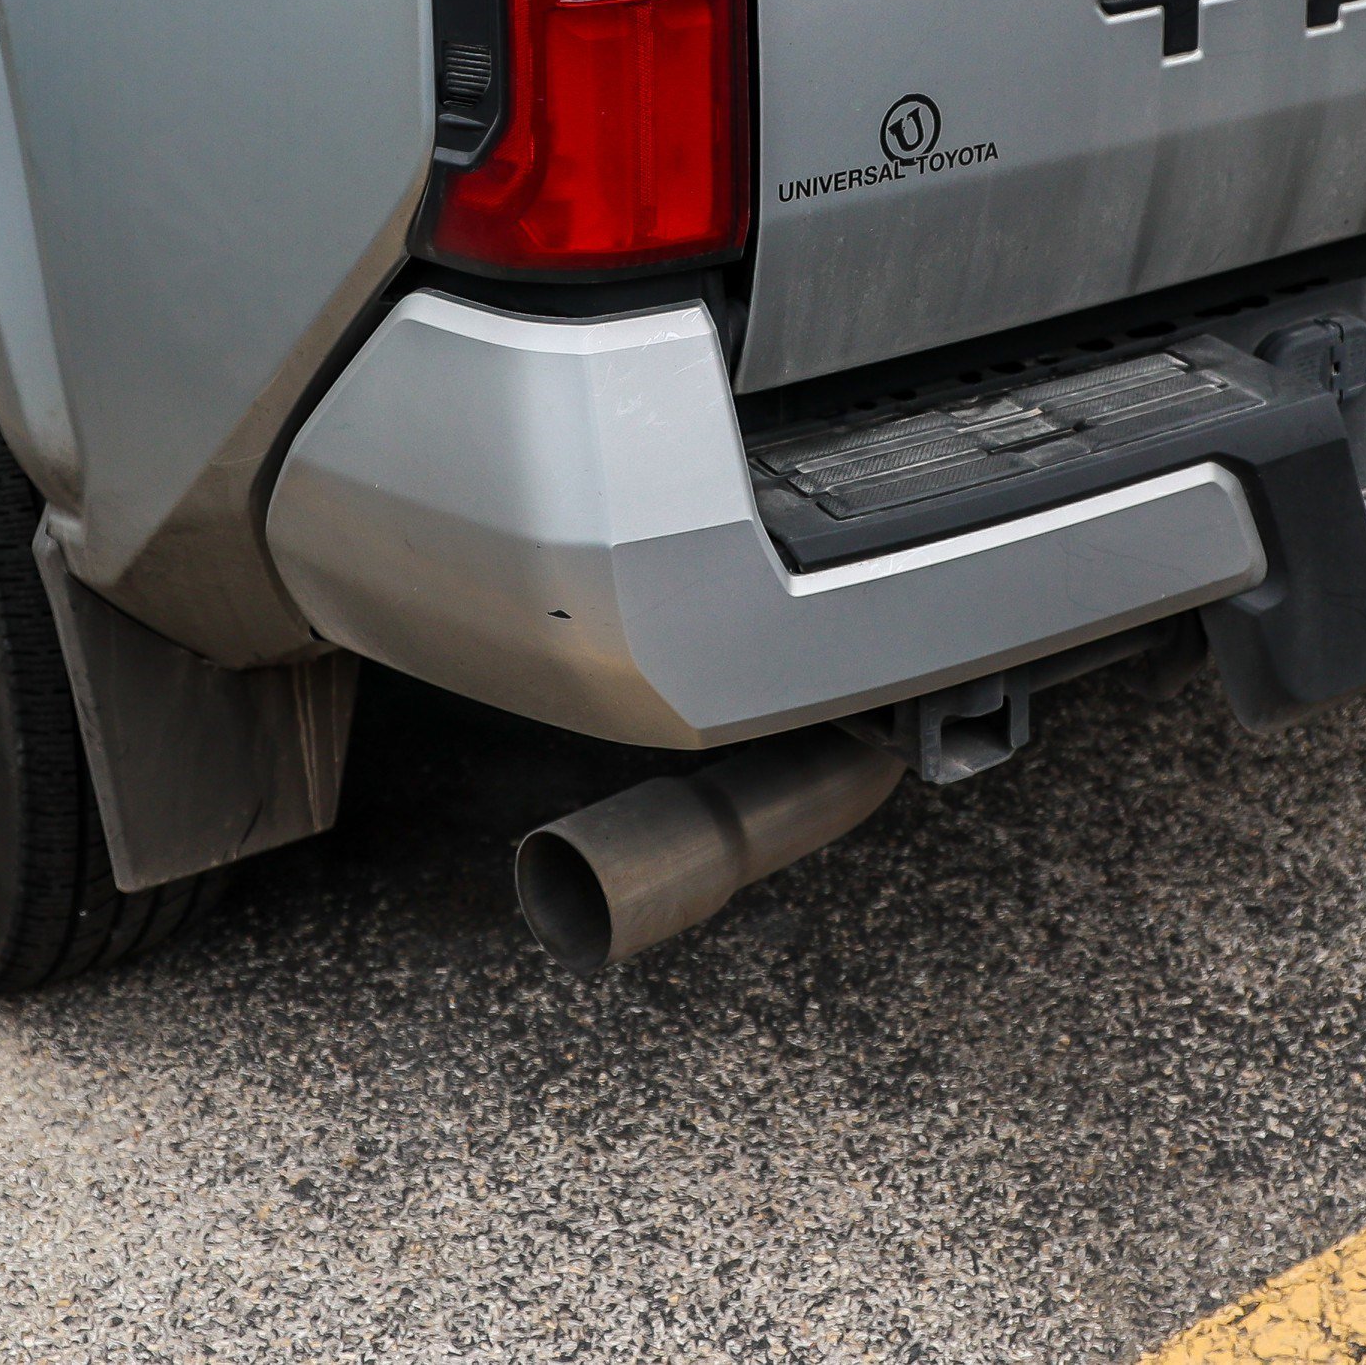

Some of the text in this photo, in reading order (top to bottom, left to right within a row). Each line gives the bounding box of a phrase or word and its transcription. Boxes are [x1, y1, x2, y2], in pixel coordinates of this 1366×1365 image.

[888, 107, 925, 152] U
[778, 142, 999, 203] UNIVERSAL TOYOTA
